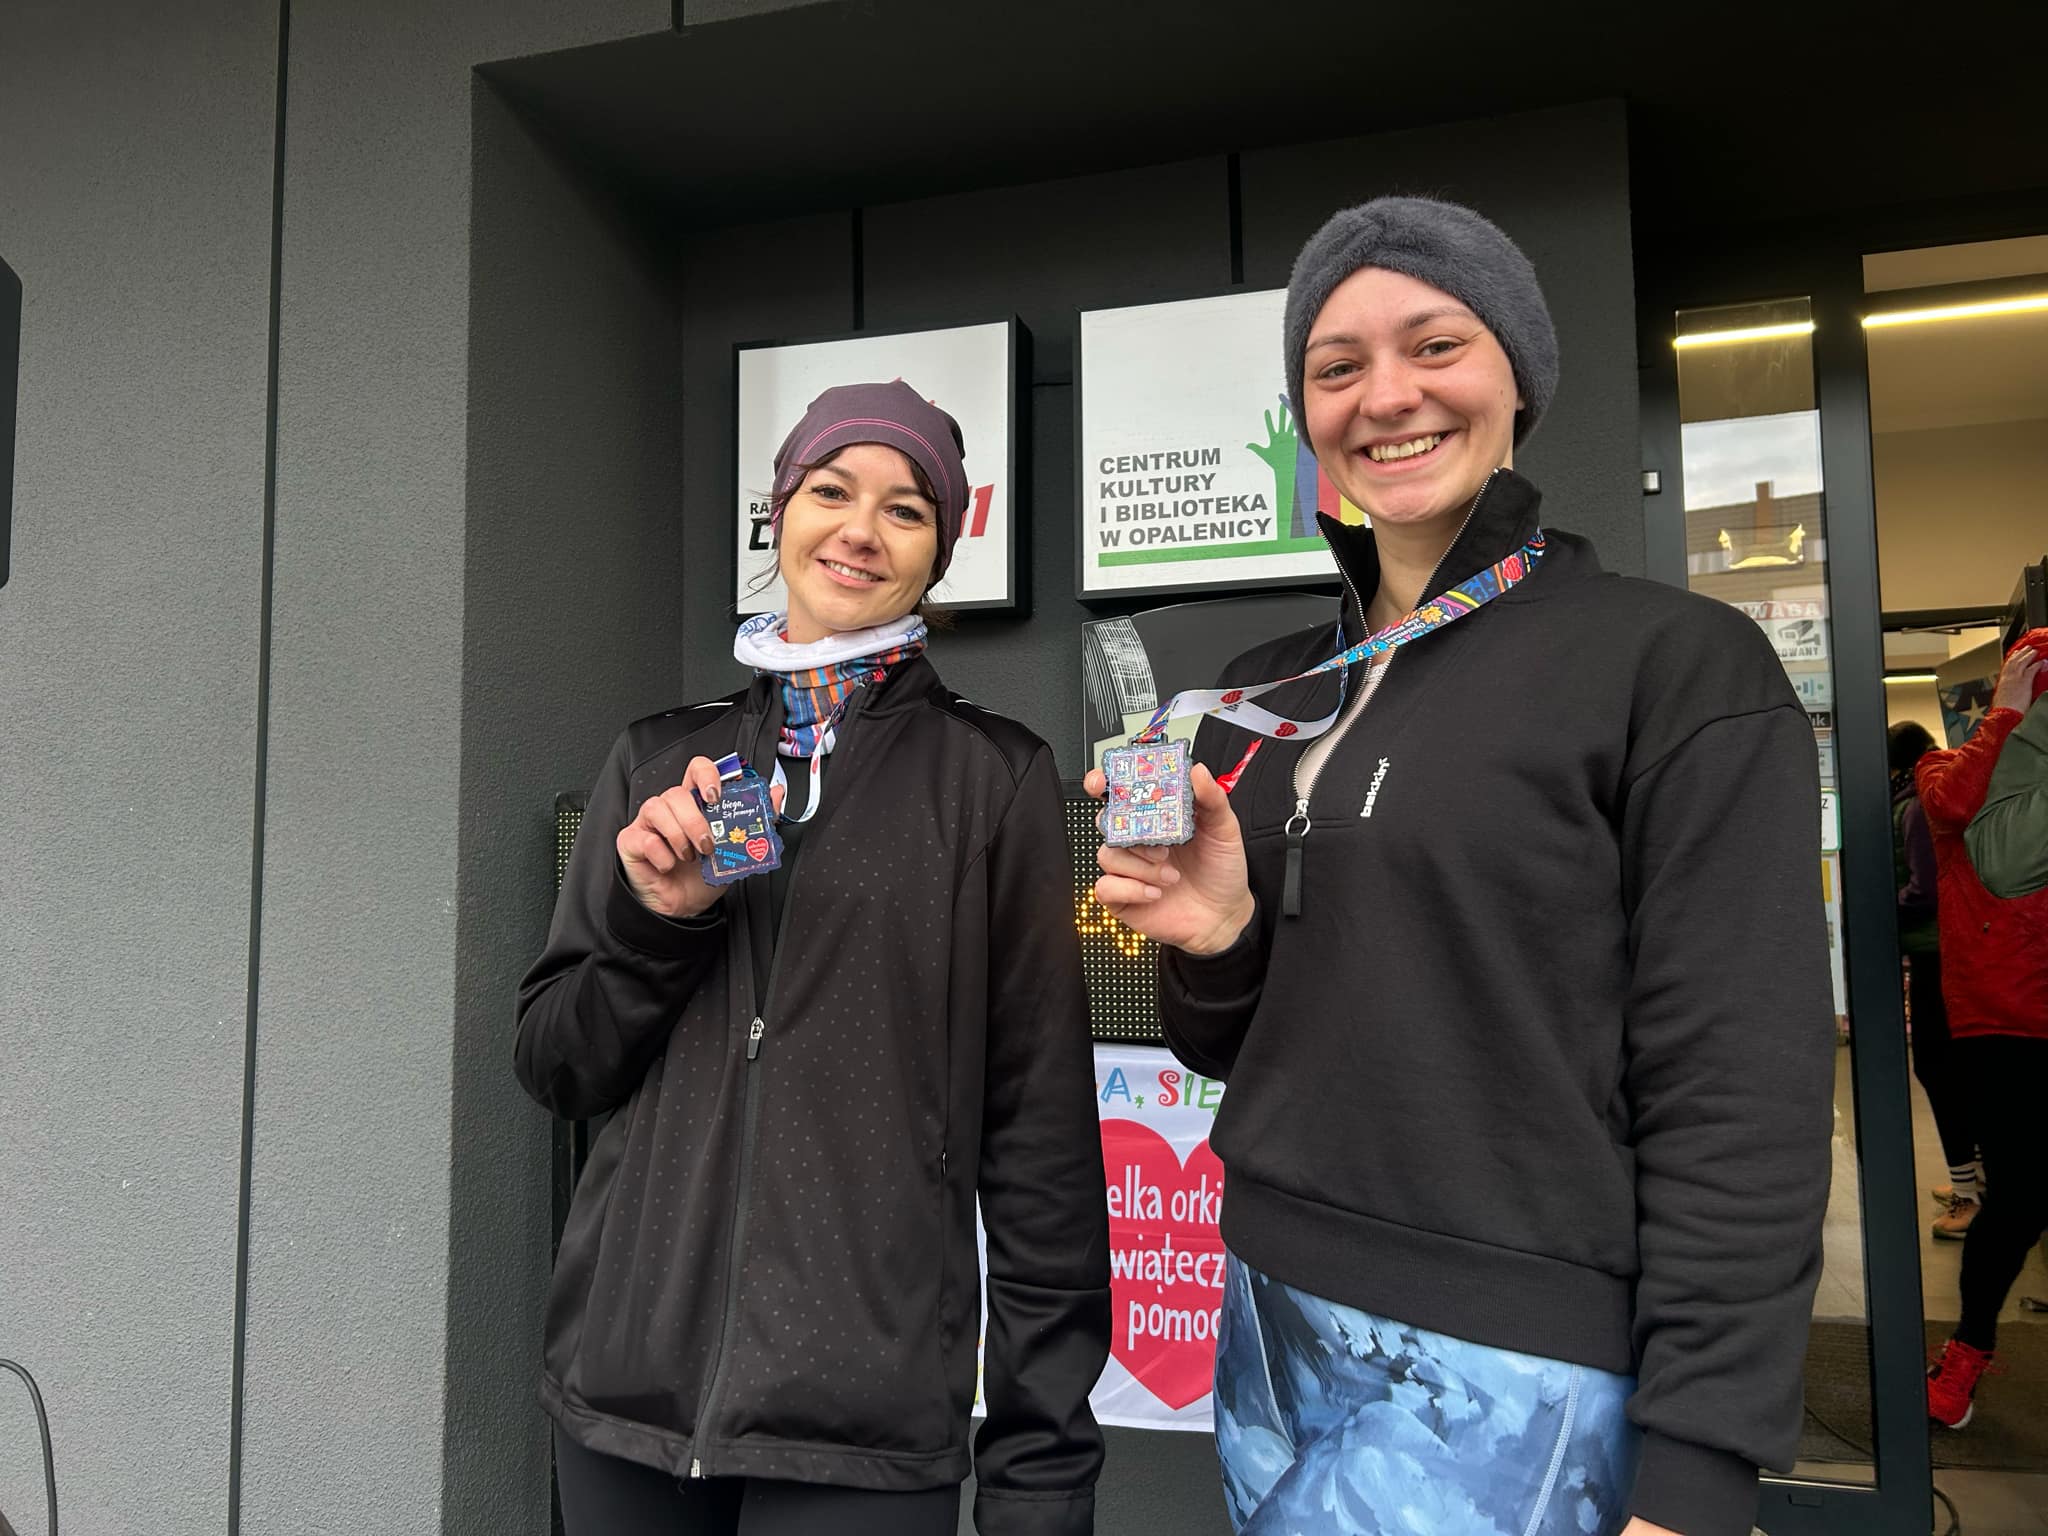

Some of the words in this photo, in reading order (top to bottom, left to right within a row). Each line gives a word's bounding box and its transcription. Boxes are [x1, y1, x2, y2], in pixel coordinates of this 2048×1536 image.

[1099, 447, 1221, 475] CENTRUM
[1100, 472, 1217, 499] KULTURY
[1100, 506, 1107, 524] I
[1115, 493, 1269, 523] BIBLIOTEKA
[1099, 529, 1121, 548] W
[1128, 517, 1273, 546] OPALENICY
